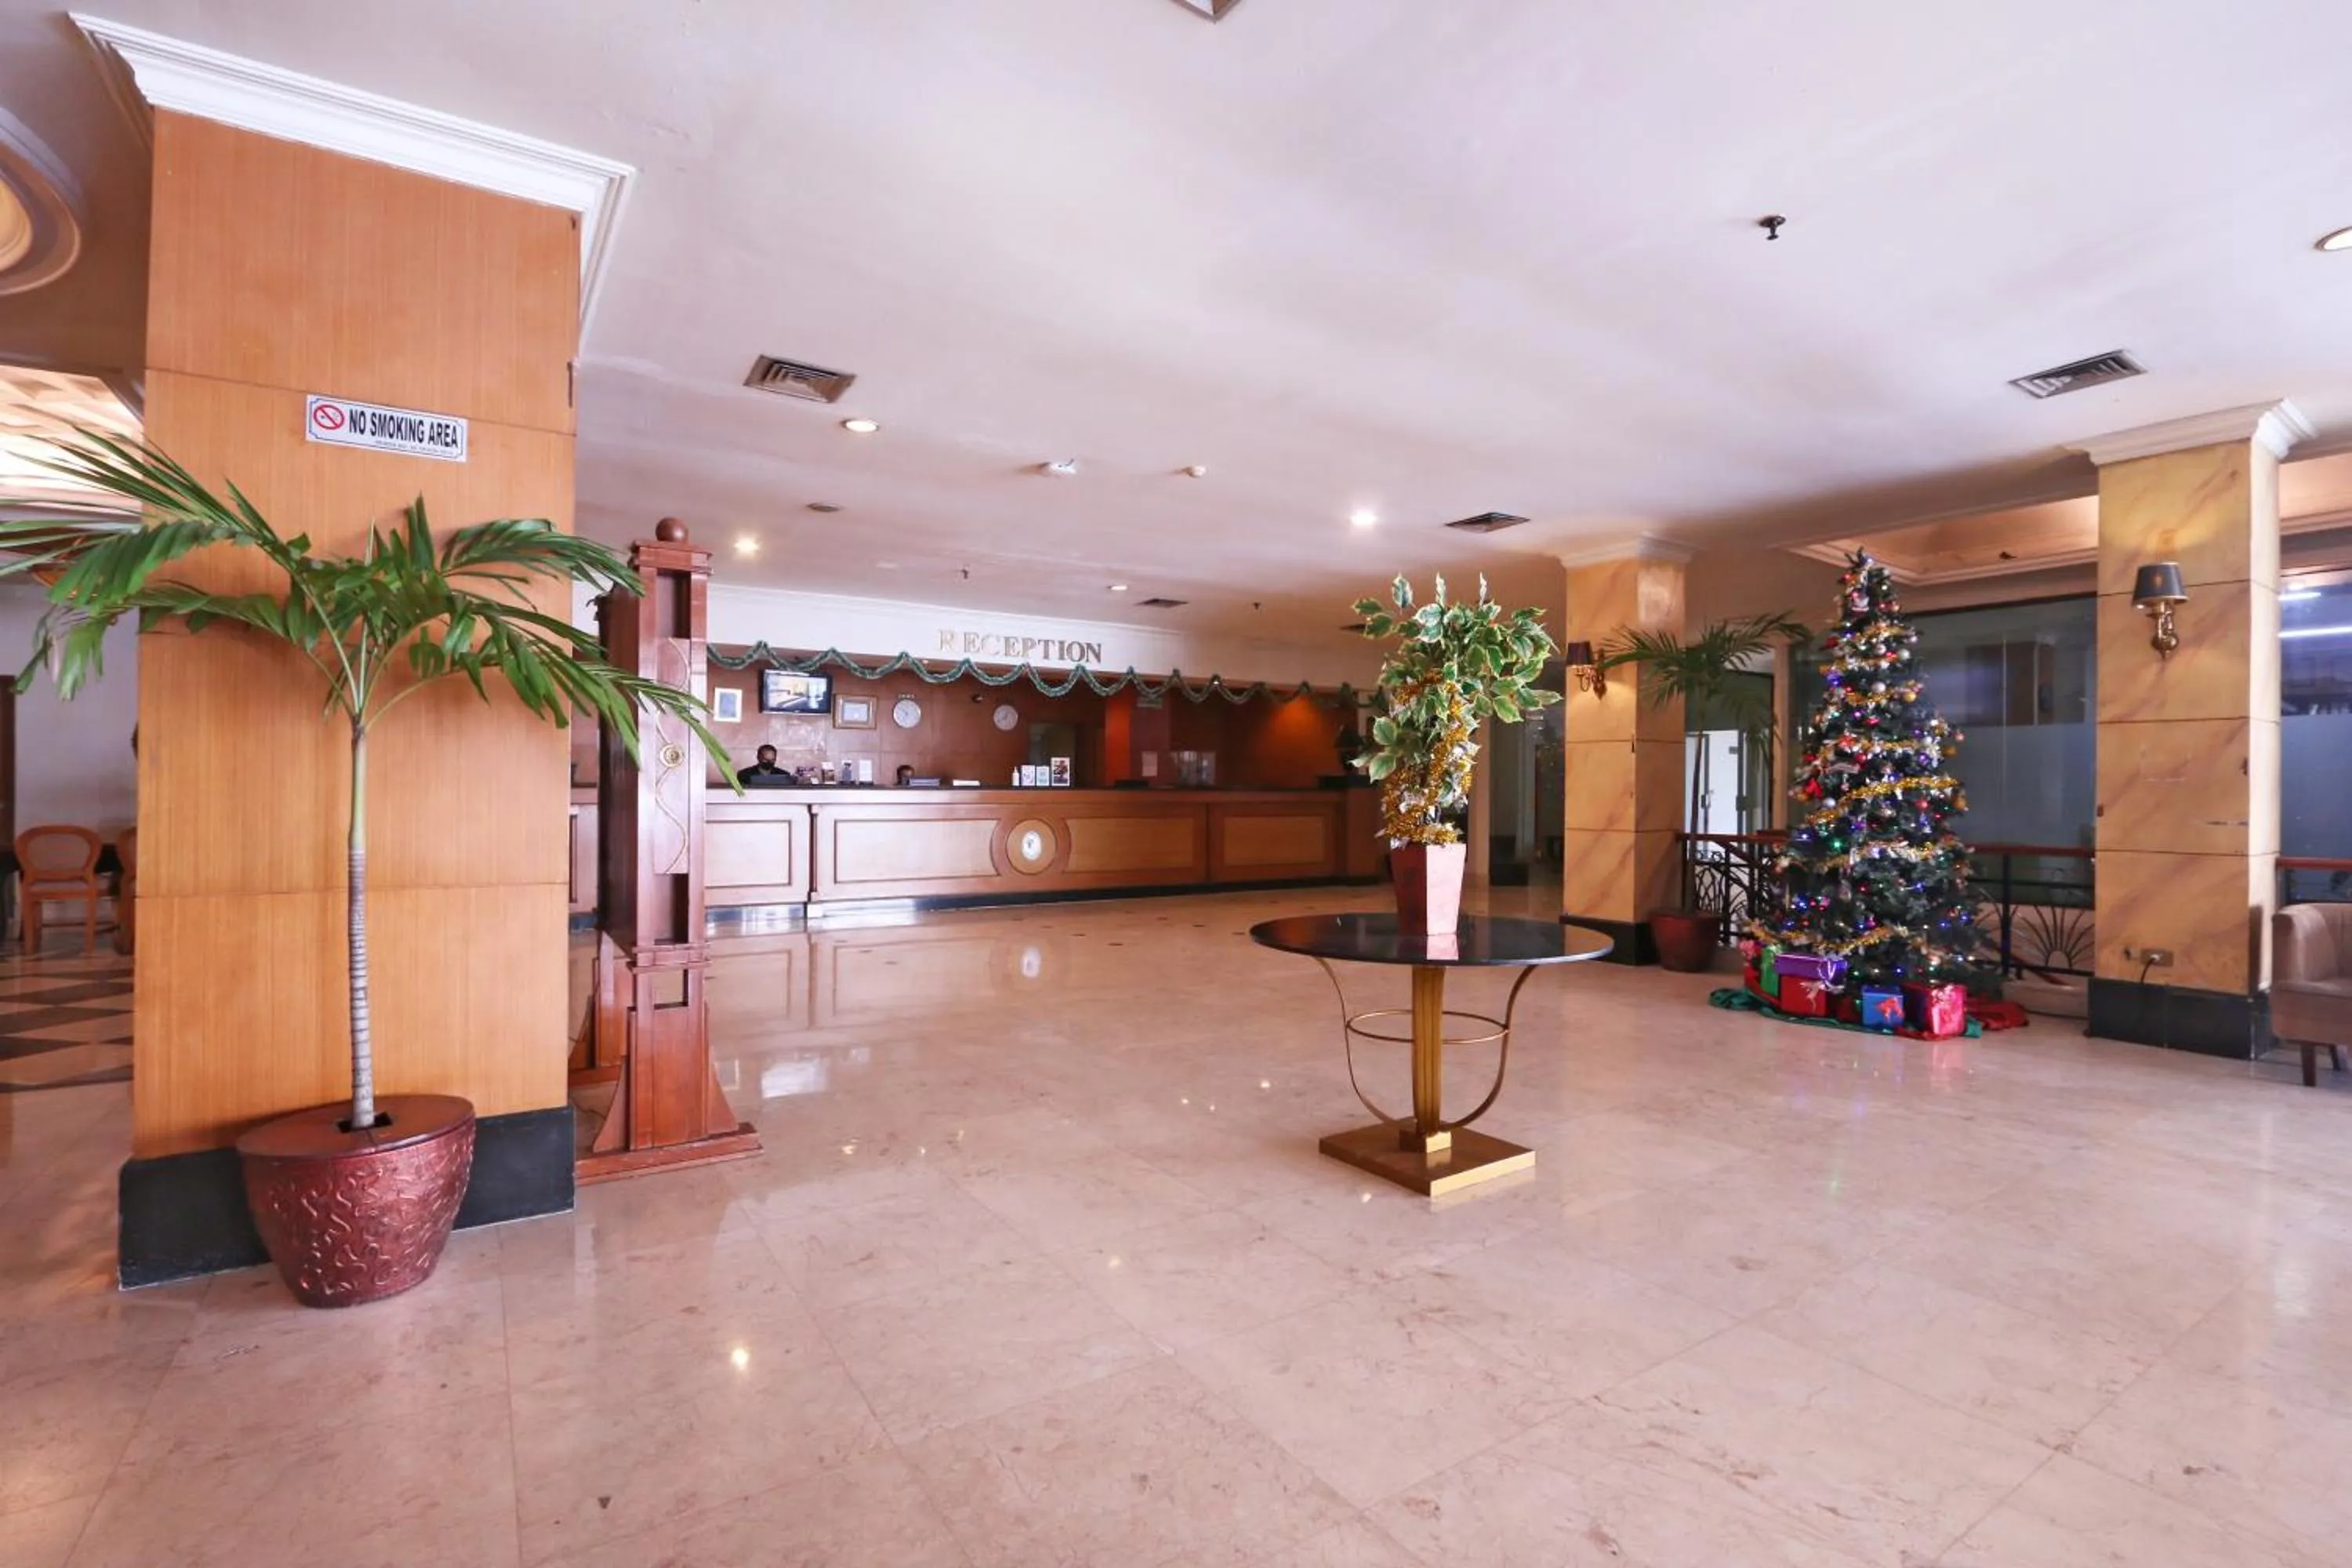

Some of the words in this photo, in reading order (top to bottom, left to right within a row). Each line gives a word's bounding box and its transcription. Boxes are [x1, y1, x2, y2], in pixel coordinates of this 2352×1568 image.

[349, 409, 366, 435] NO
[370, 412, 424, 443] SMOKING
[427, 422, 459, 448] AREA
[939, 630, 1102, 663] RECEPTION
